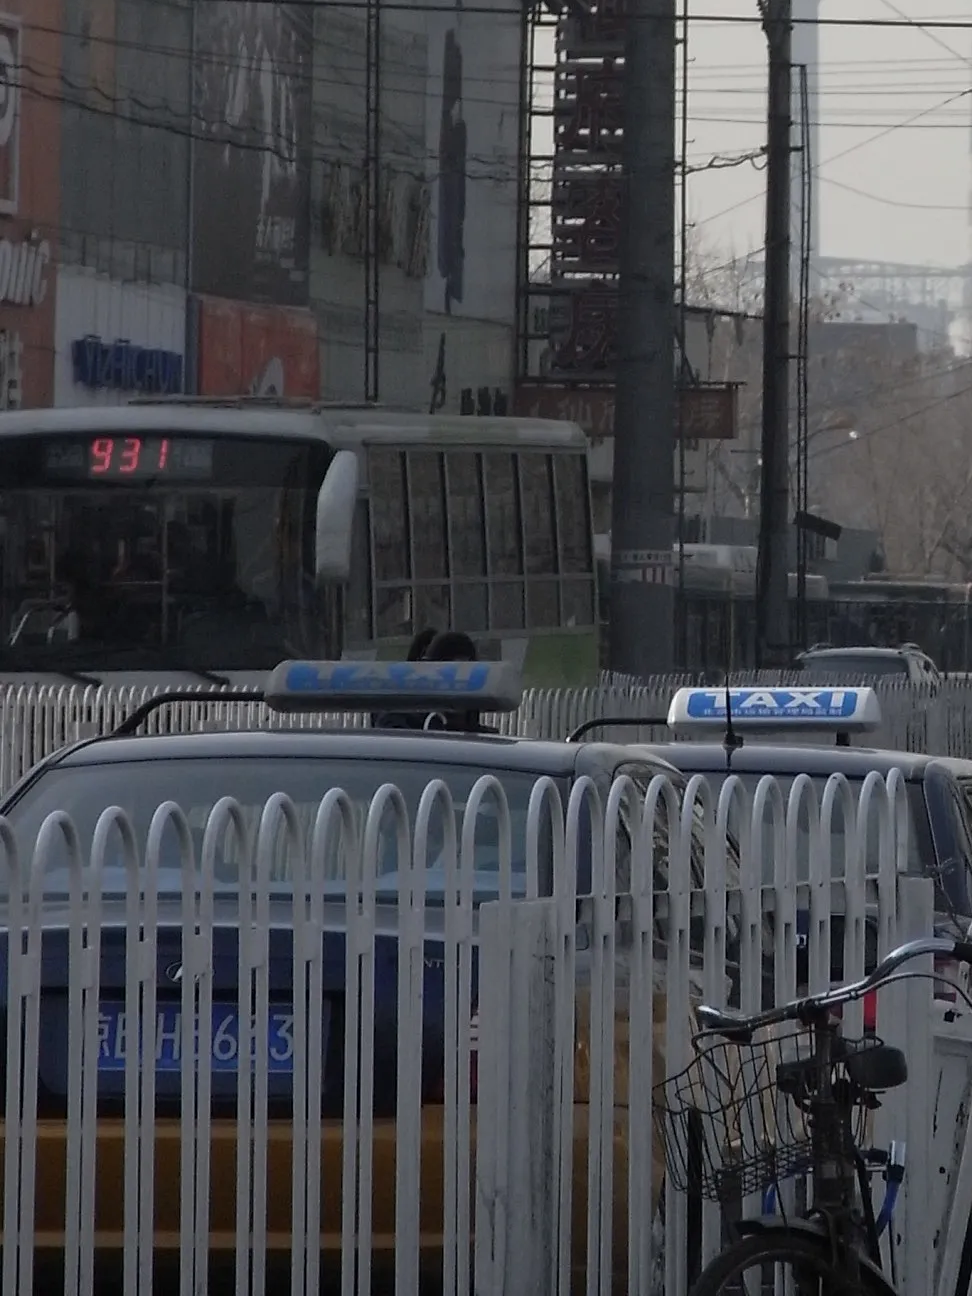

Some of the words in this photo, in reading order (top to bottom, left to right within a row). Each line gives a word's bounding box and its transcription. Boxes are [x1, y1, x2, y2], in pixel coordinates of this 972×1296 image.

[90, 437, 169, 473] 931
[704, 692, 846, 708] TAXI
[156, 1013, 293, 1061] H63
